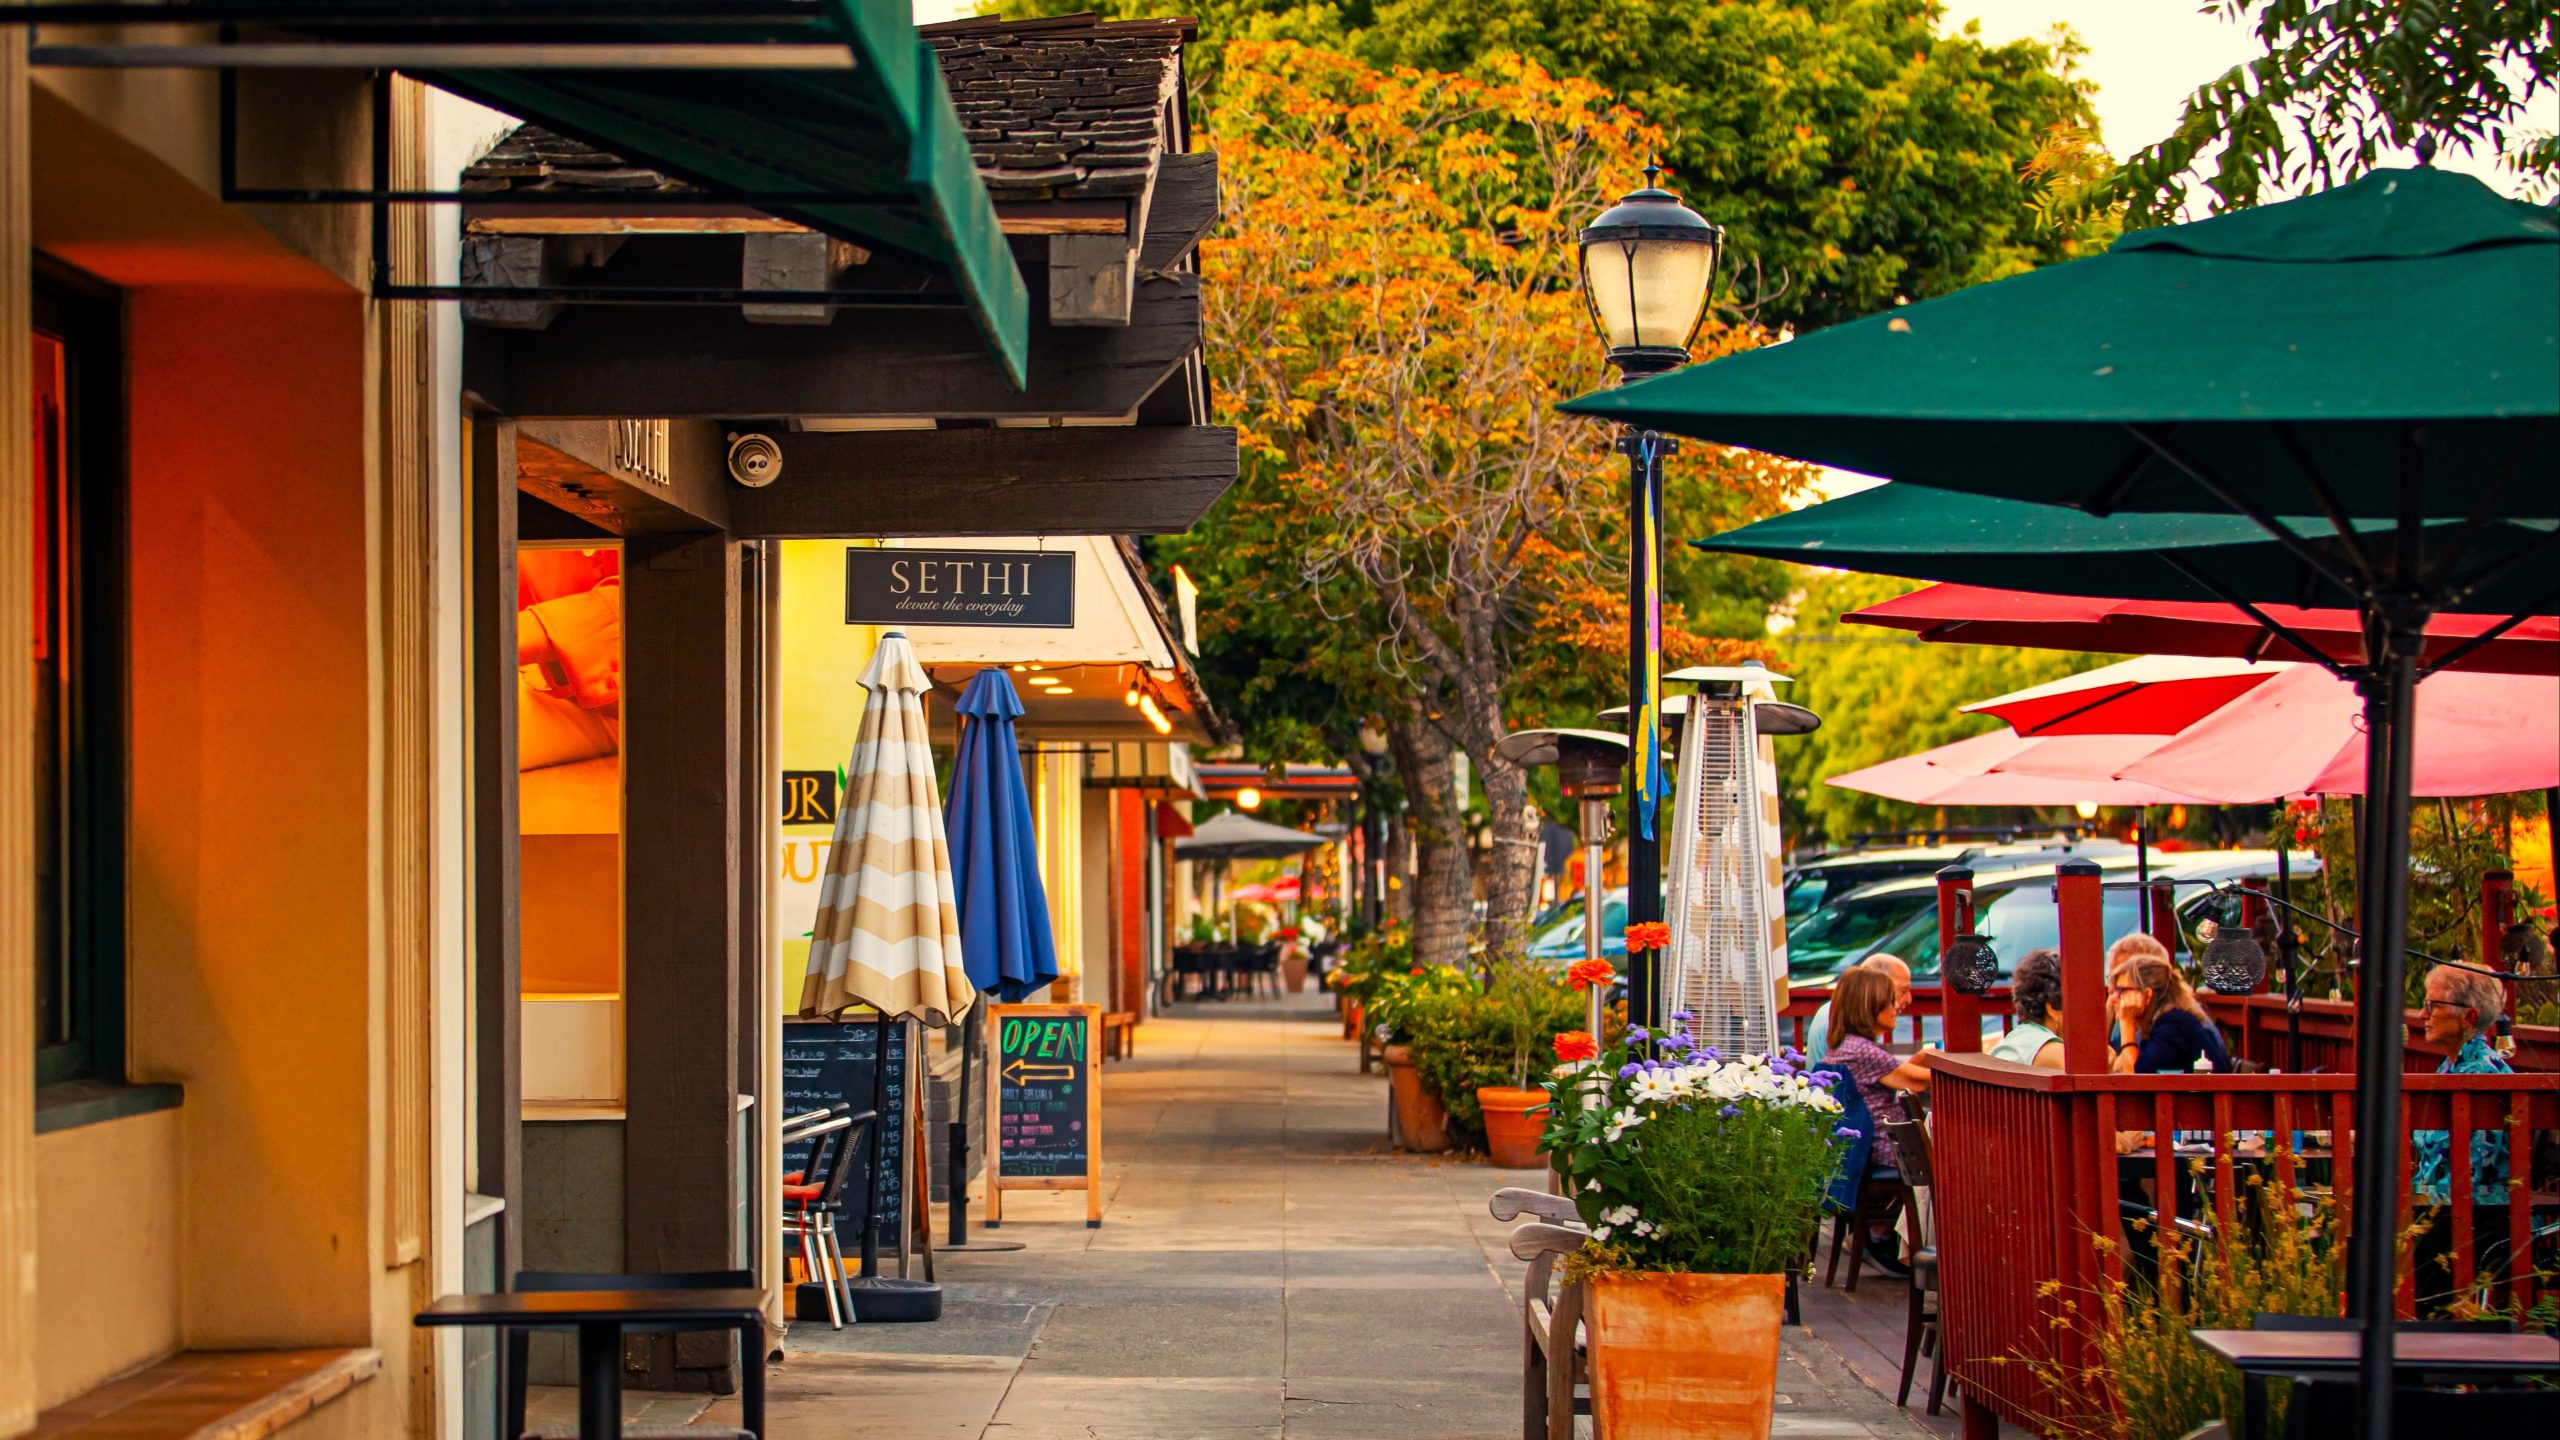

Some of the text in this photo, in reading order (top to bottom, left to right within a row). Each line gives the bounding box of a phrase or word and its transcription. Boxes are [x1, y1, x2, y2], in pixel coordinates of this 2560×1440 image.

[890, 561, 1031, 595] SETHI
[895, 596, 1025, 617] elevate the everyday
[1002, 1019, 1085, 1062] OPEN
